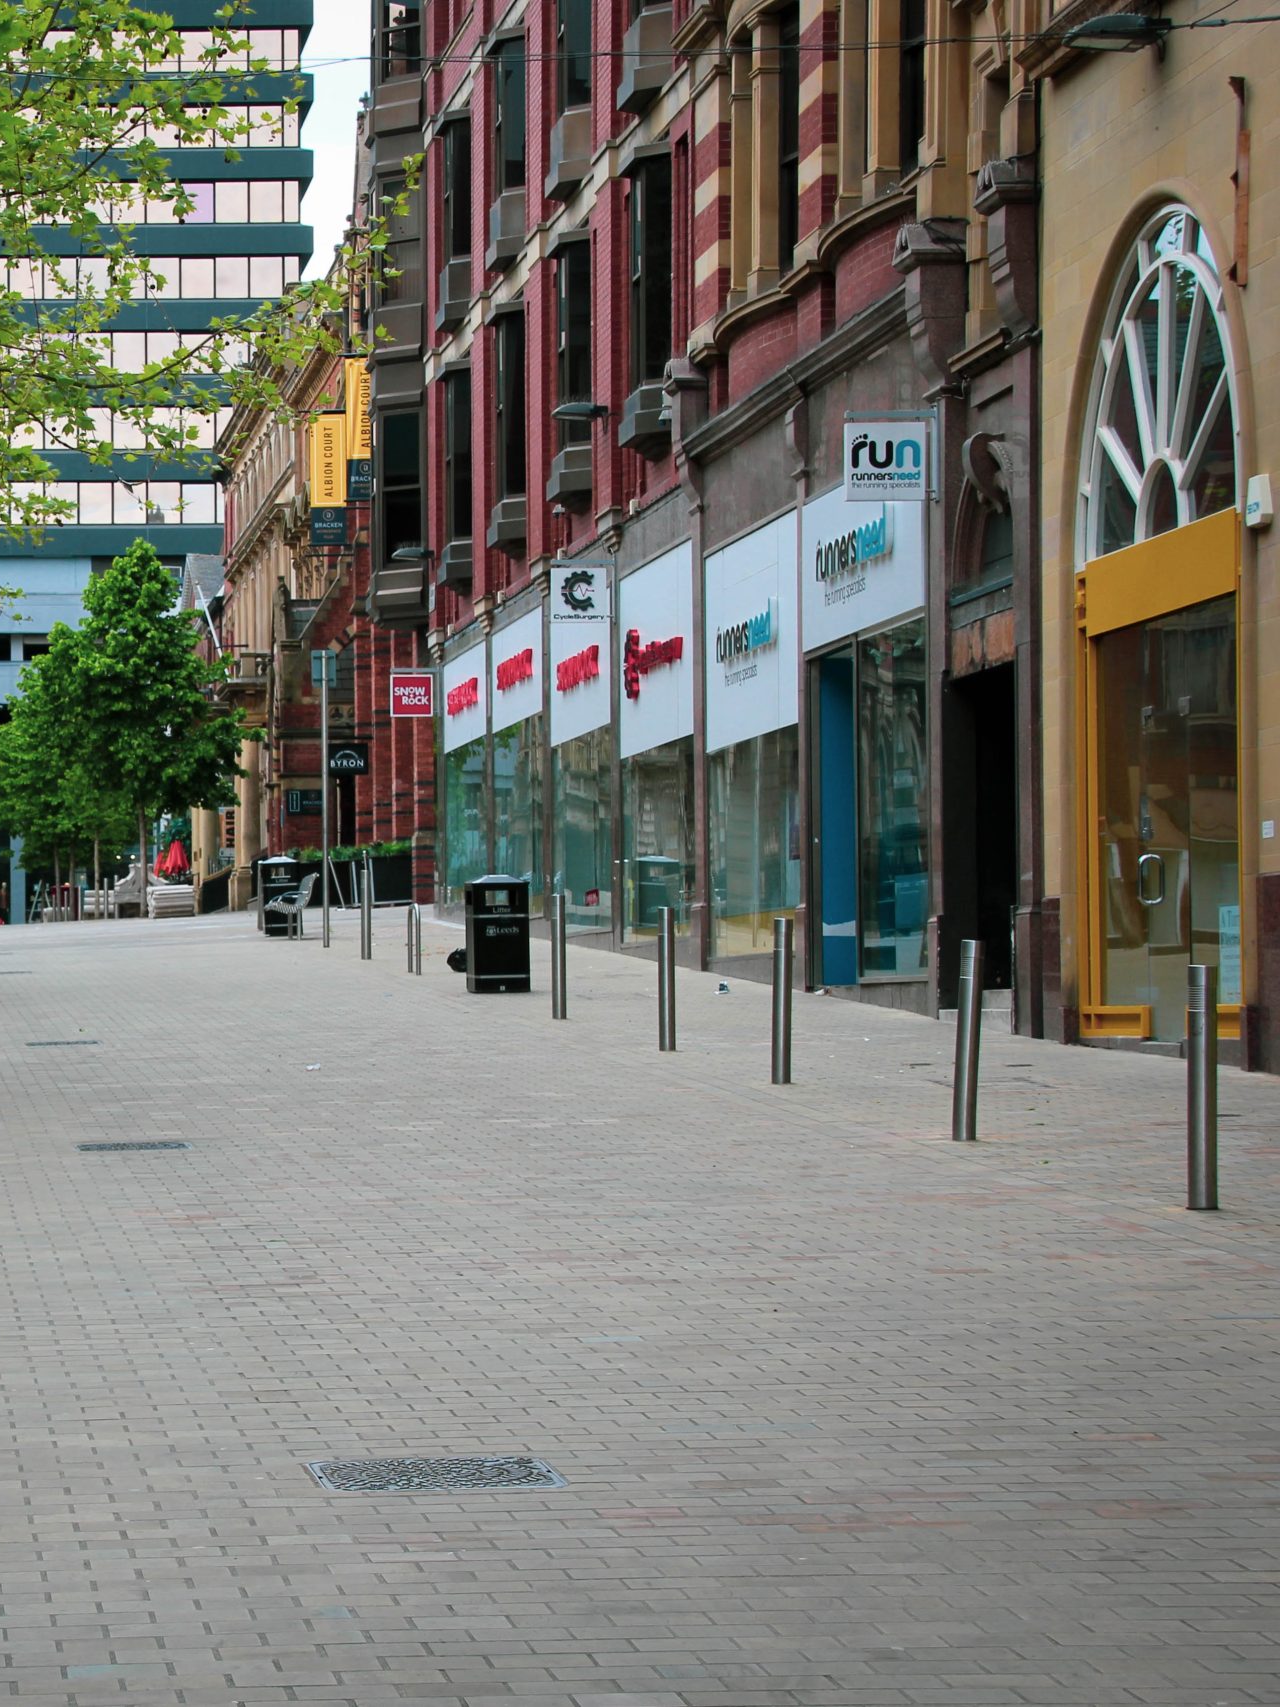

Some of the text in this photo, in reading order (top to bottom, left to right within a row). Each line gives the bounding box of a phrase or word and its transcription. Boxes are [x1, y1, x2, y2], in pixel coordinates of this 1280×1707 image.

[360, 371, 371, 449] ALBION COURT
[324, 426, 334, 497] ALBION COURT
[851, 434, 920, 469] run
[851, 470, 920, 481] runnersneed
[816, 501, 886, 581] runnersneed
[716, 597, 771, 663] runnersneed
[394, 686, 425, 696] SNOW
[330, 759, 364, 767] BYRON
[226, 810, 235, 848] HAIR
